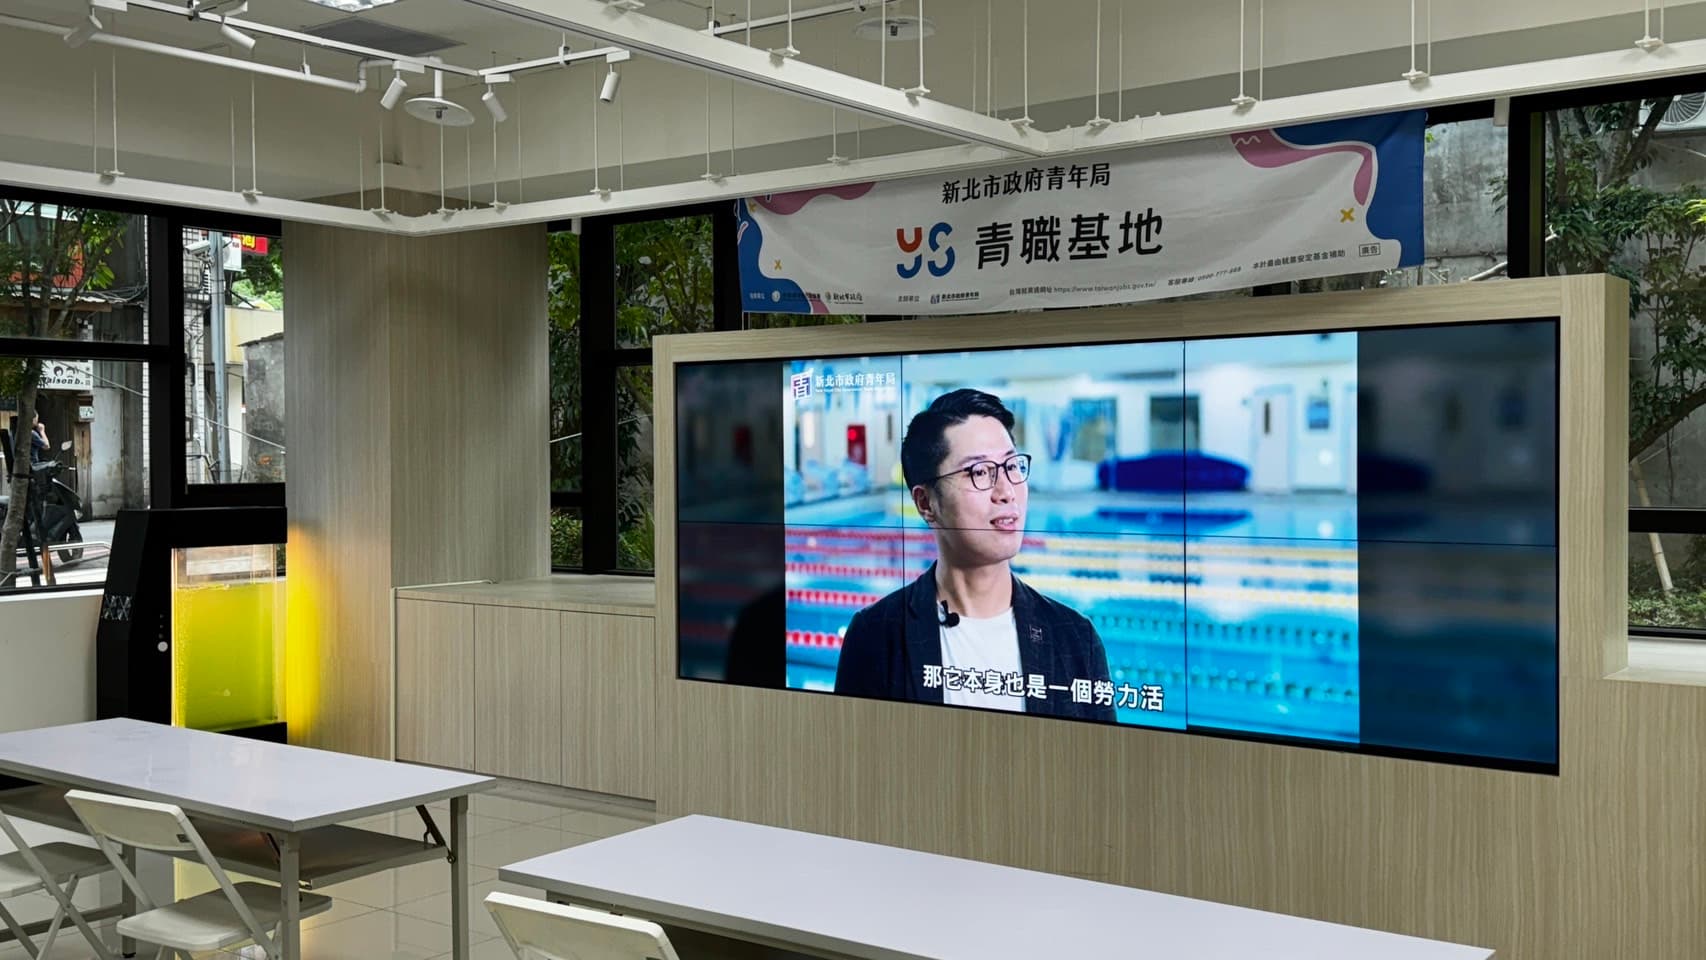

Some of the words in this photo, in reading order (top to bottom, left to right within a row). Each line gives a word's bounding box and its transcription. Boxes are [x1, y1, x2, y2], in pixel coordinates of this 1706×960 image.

[942, 163, 1110, 204] 新北市政府青年局
[975, 207, 1164, 270] 青職基地
[1361, 245, 1378, 255] 廣告
[815, 372, 896, 388] 新北市政府青年局
[923, 664, 1165, 711] 那它本身也是一個勞力活
